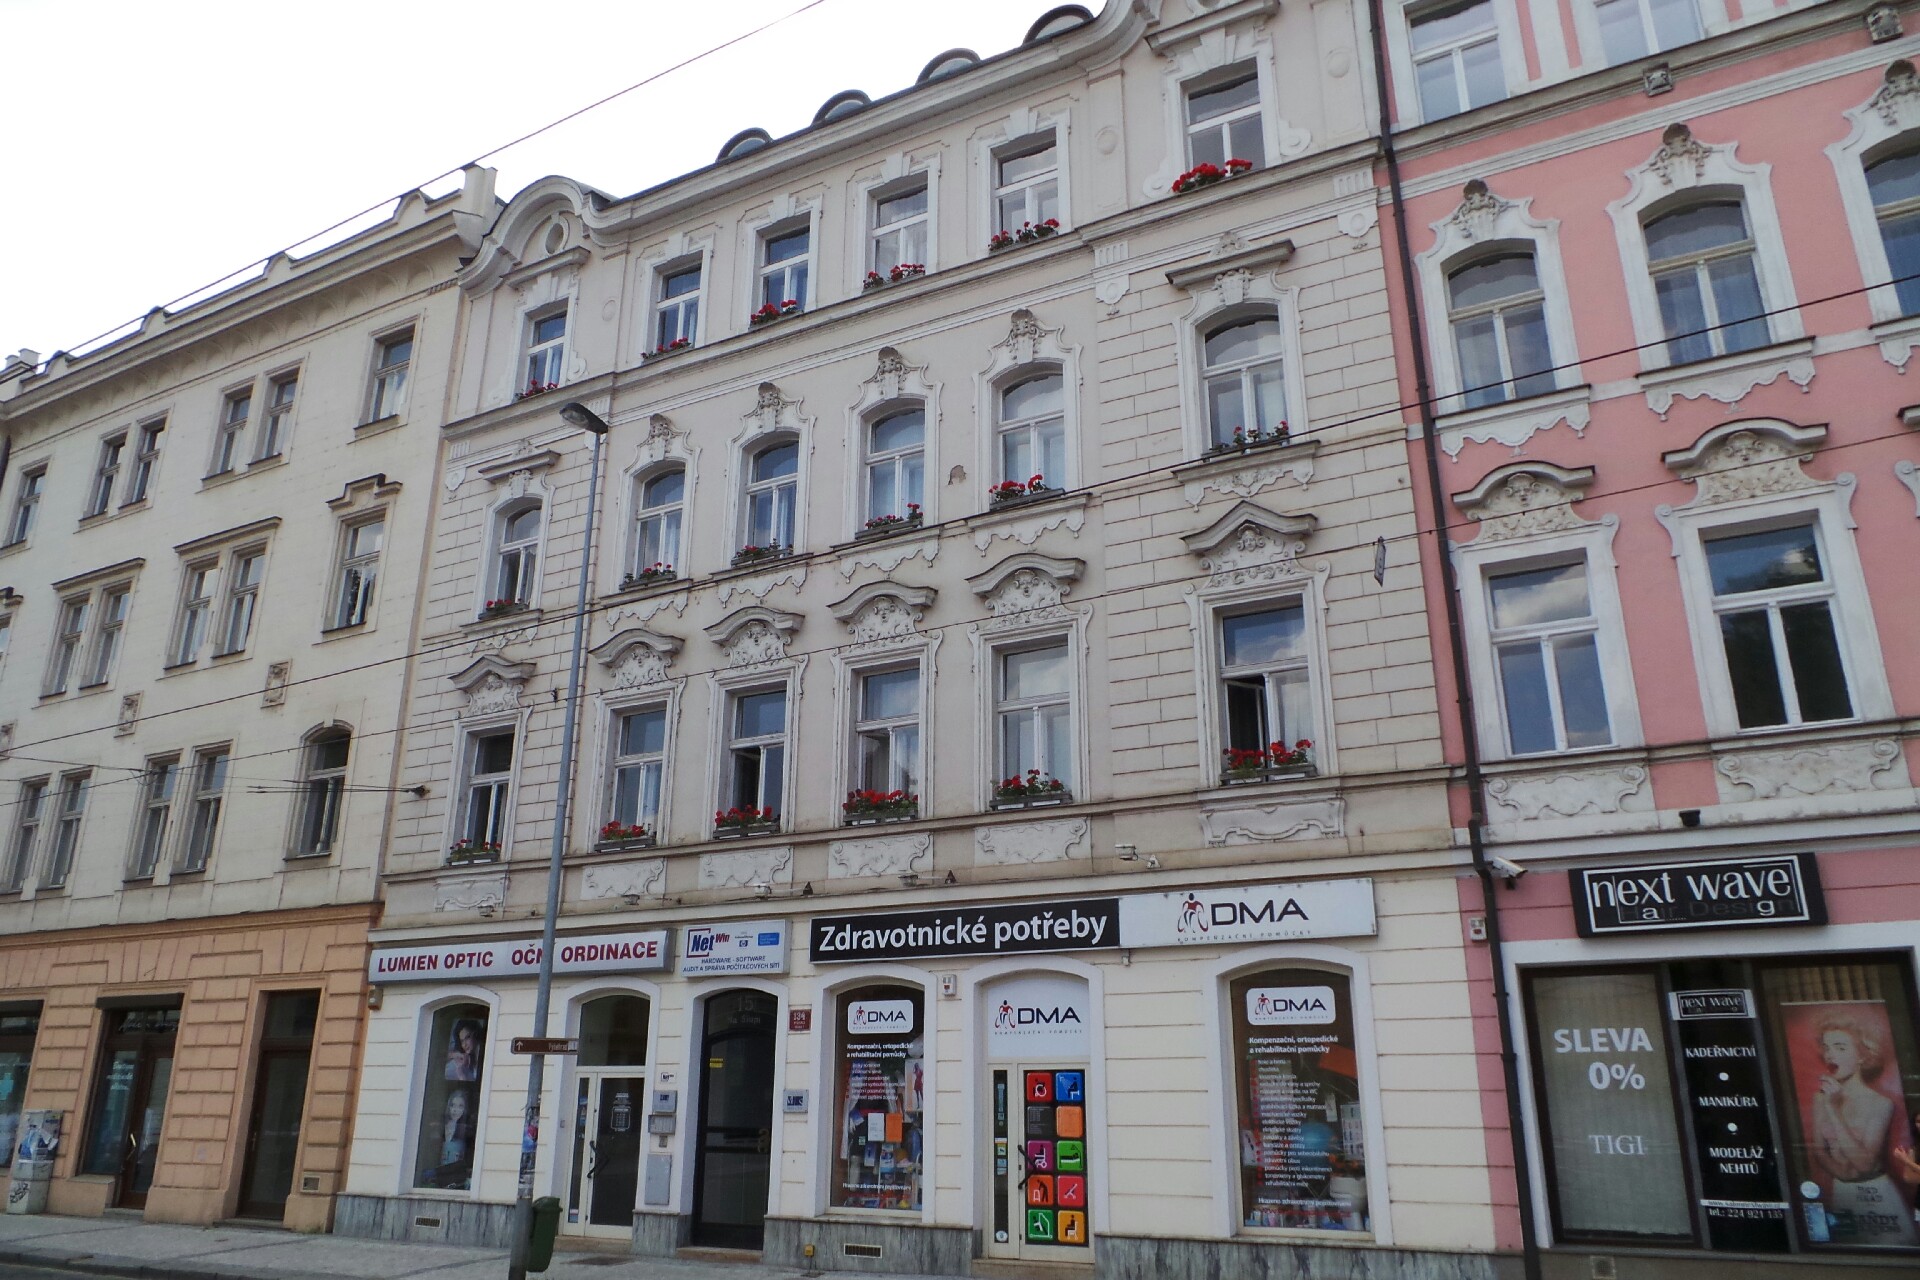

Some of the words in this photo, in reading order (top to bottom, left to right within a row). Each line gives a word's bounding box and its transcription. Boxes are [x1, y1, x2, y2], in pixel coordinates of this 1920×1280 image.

[1592, 871, 1675, 908] next
[1685, 867, 1791, 901] wave
[1211, 897, 1310, 926] DMA
[819, 915, 987, 951] Zdravotnické
[994, 909, 1107, 949] potřeby
[690, 934, 715, 952] Net
[715, 932, 730, 944] Win
[378, 954, 439, 973] LUMIEN
[443, 950, 494, 969] OPTIC
[511, 943, 544, 966] OČN
[560, 940, 658, 963] ORDINACE
[735, 955, 766, 963] SOFTWARE
[1273, 998, 1327, 1012] DMA
[1681, 996, 1706, 1008] next
[1709, 996, 1741, 1007] wave
[867, 1010, 907, 1022] DMA
[1017, 1006, 1082, 1024] DMA
[1249, 1036, 1296, 1045] Kompenzační,
[1553, 1027, 1654, 1053] SLEVA
[1297, 1045, 1330, 1054] pomůcky
[1685, 1044, 1757, 1058] KADEŘNICTVÍ
[1588, 1061, 1646, 1090] 0%
[1698, 1094, 1759, 1107] MANIKÚRA
[1588, 1134, 1646, 1155] TIGI
[1709, 1145, 1764, 1159] MODELÁŽ
[1719, 1161, 1759, 1174] NEHTŮ
